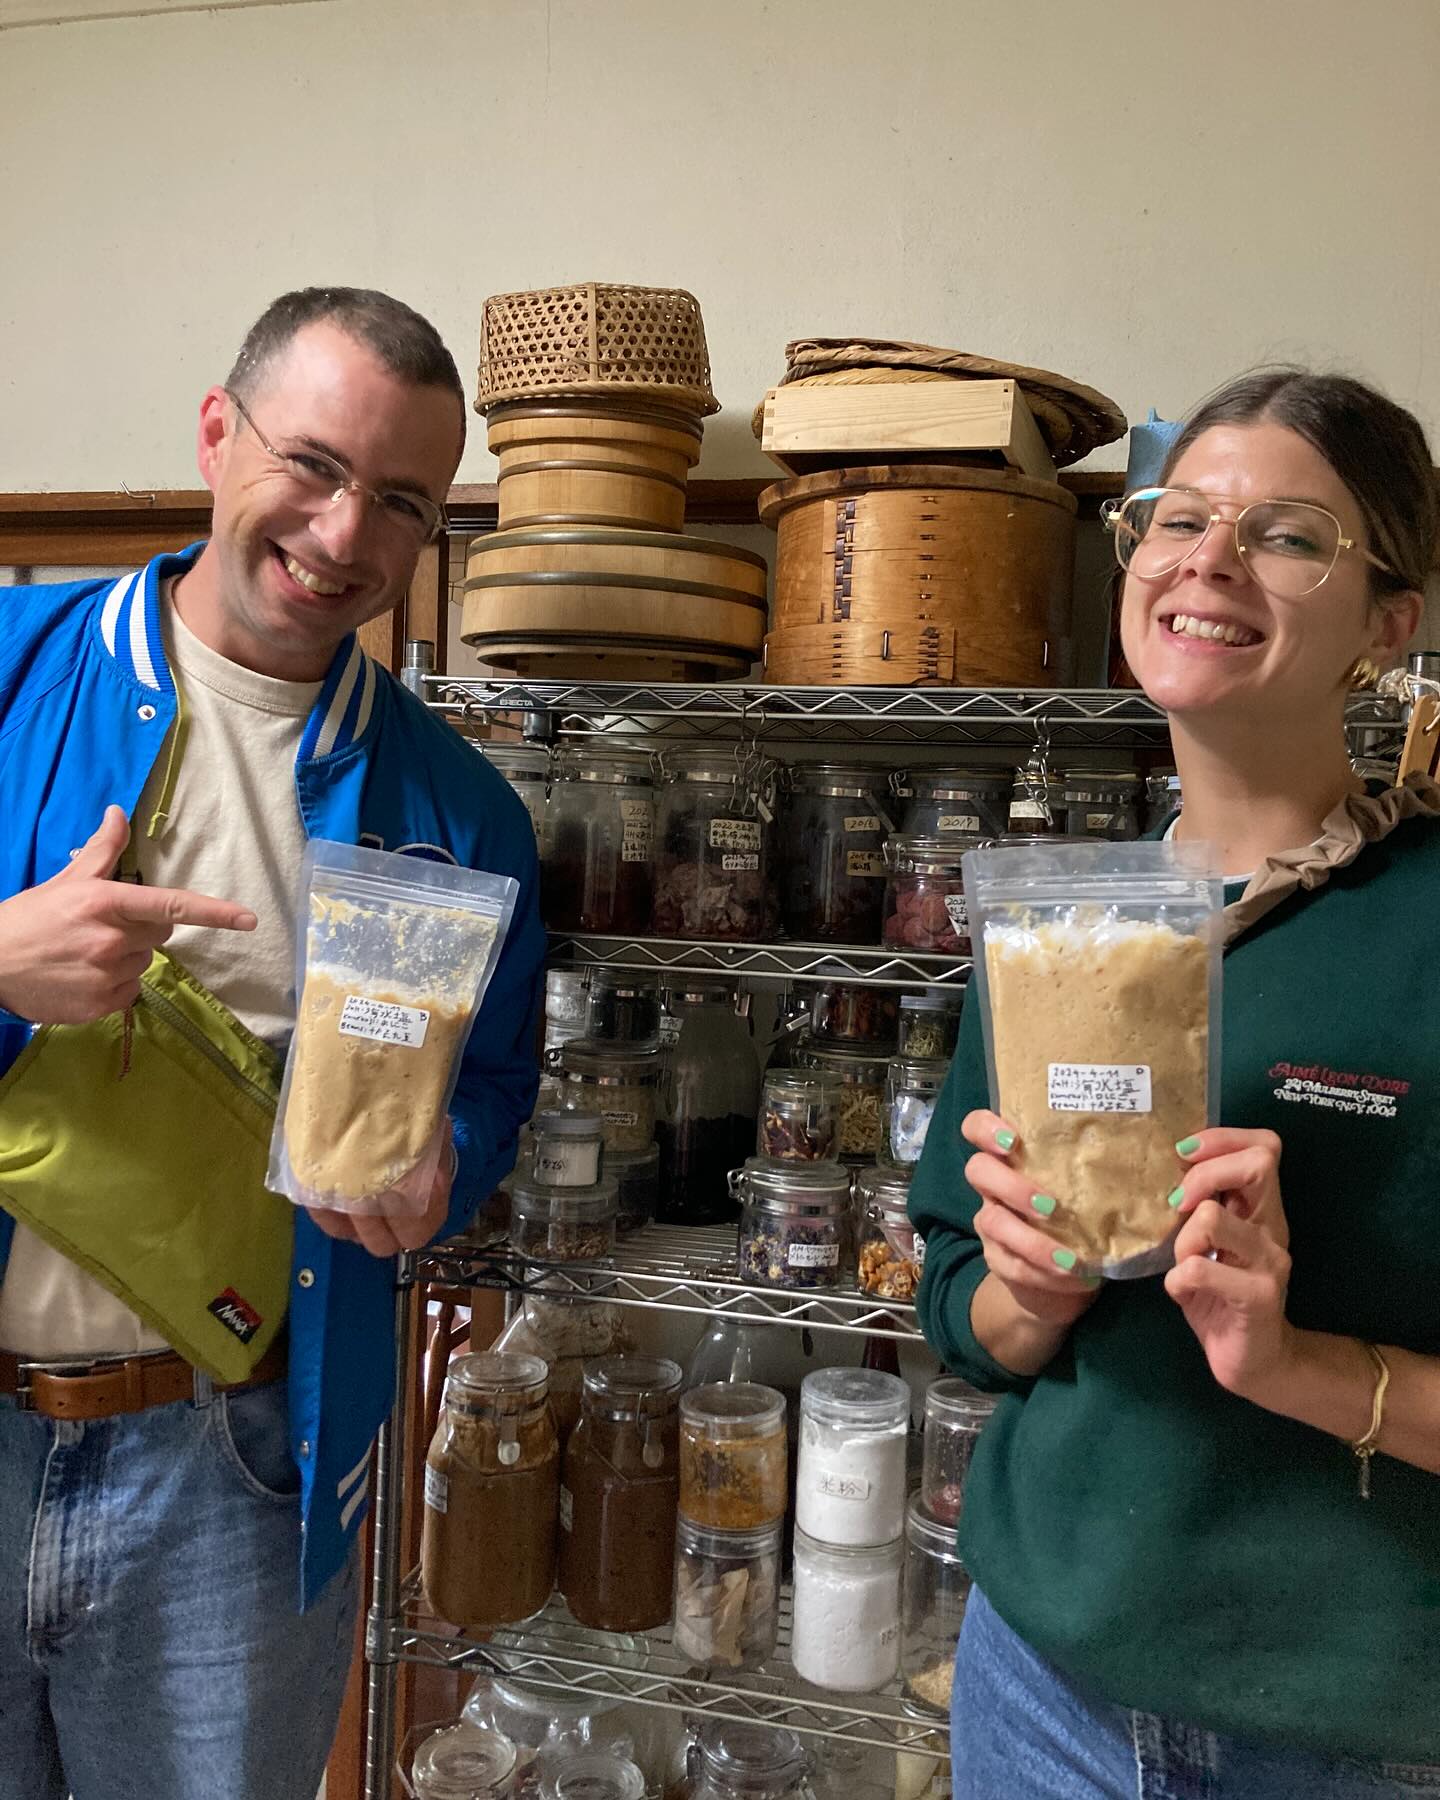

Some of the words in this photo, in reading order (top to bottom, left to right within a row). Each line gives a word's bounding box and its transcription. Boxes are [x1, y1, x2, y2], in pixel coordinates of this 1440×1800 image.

[499, 699, 534, 707] ERECTA
[1320, 1065, 1360, 1086] LEON
[1360, 1074, 1411, 1095] DORE
[1273, 1088, 1307, 1103] NEW
[1304, 1093, 1336, 1108] YORK
[1355, 1089, 1396, 1105] STREET
[821, 1476, 865, 1497] 米粉
